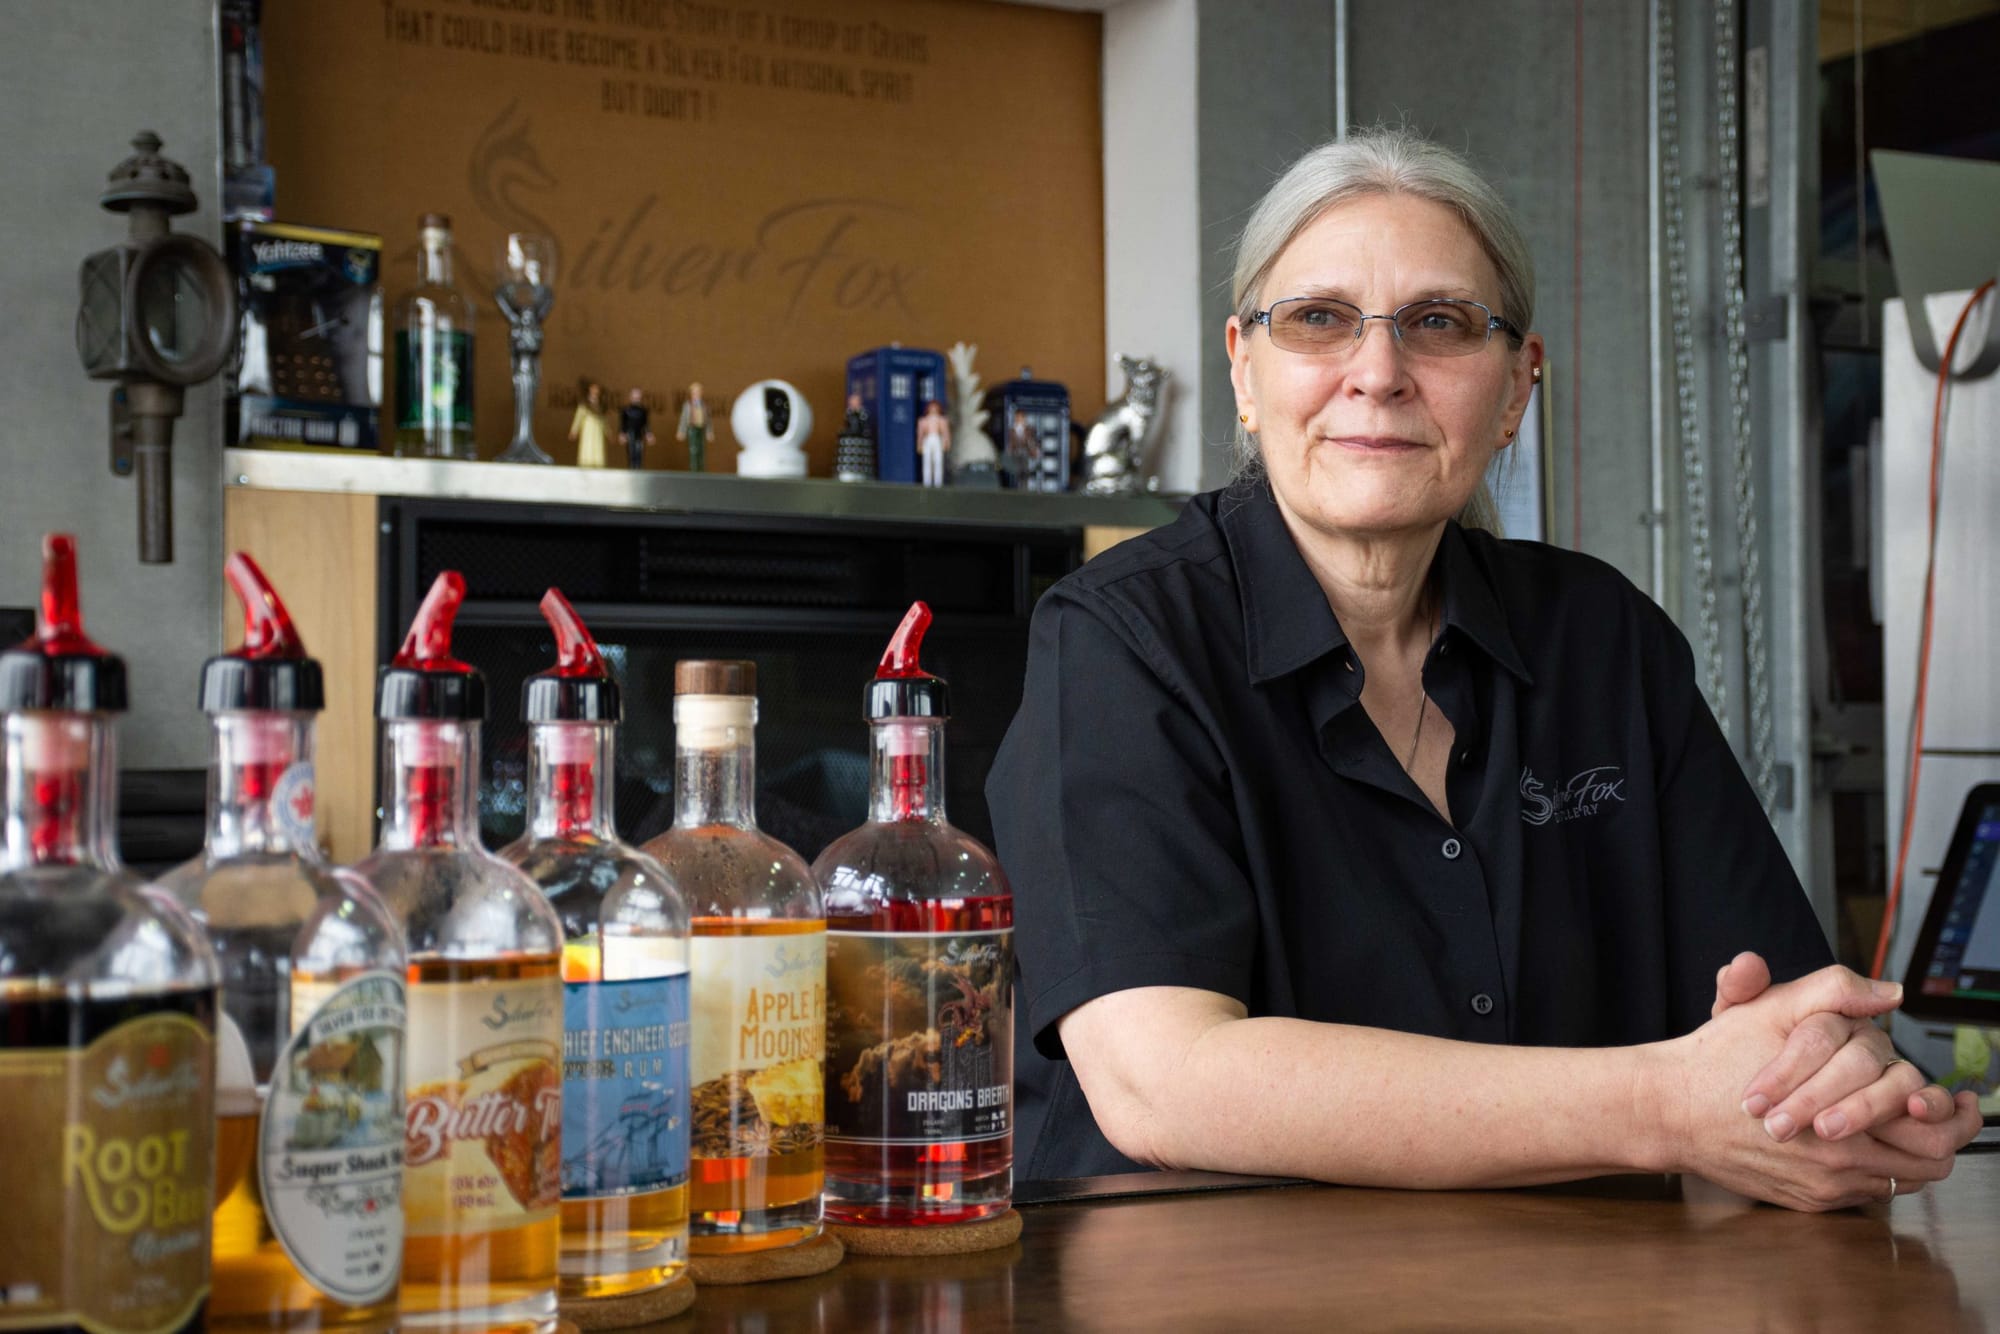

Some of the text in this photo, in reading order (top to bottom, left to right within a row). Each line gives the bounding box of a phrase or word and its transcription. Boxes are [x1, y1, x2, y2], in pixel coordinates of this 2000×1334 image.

[252, 239, 324, 263] Yahtzee
[563, 1029, 597, 1056] HIEF
[603, 1024, 666, 1055] ENGINEER
[624, 1057, 663, 1079] RUM
[907, 1089, 974, 1112] DRAGONS
[405, 1093, 528, 1165] Butter
